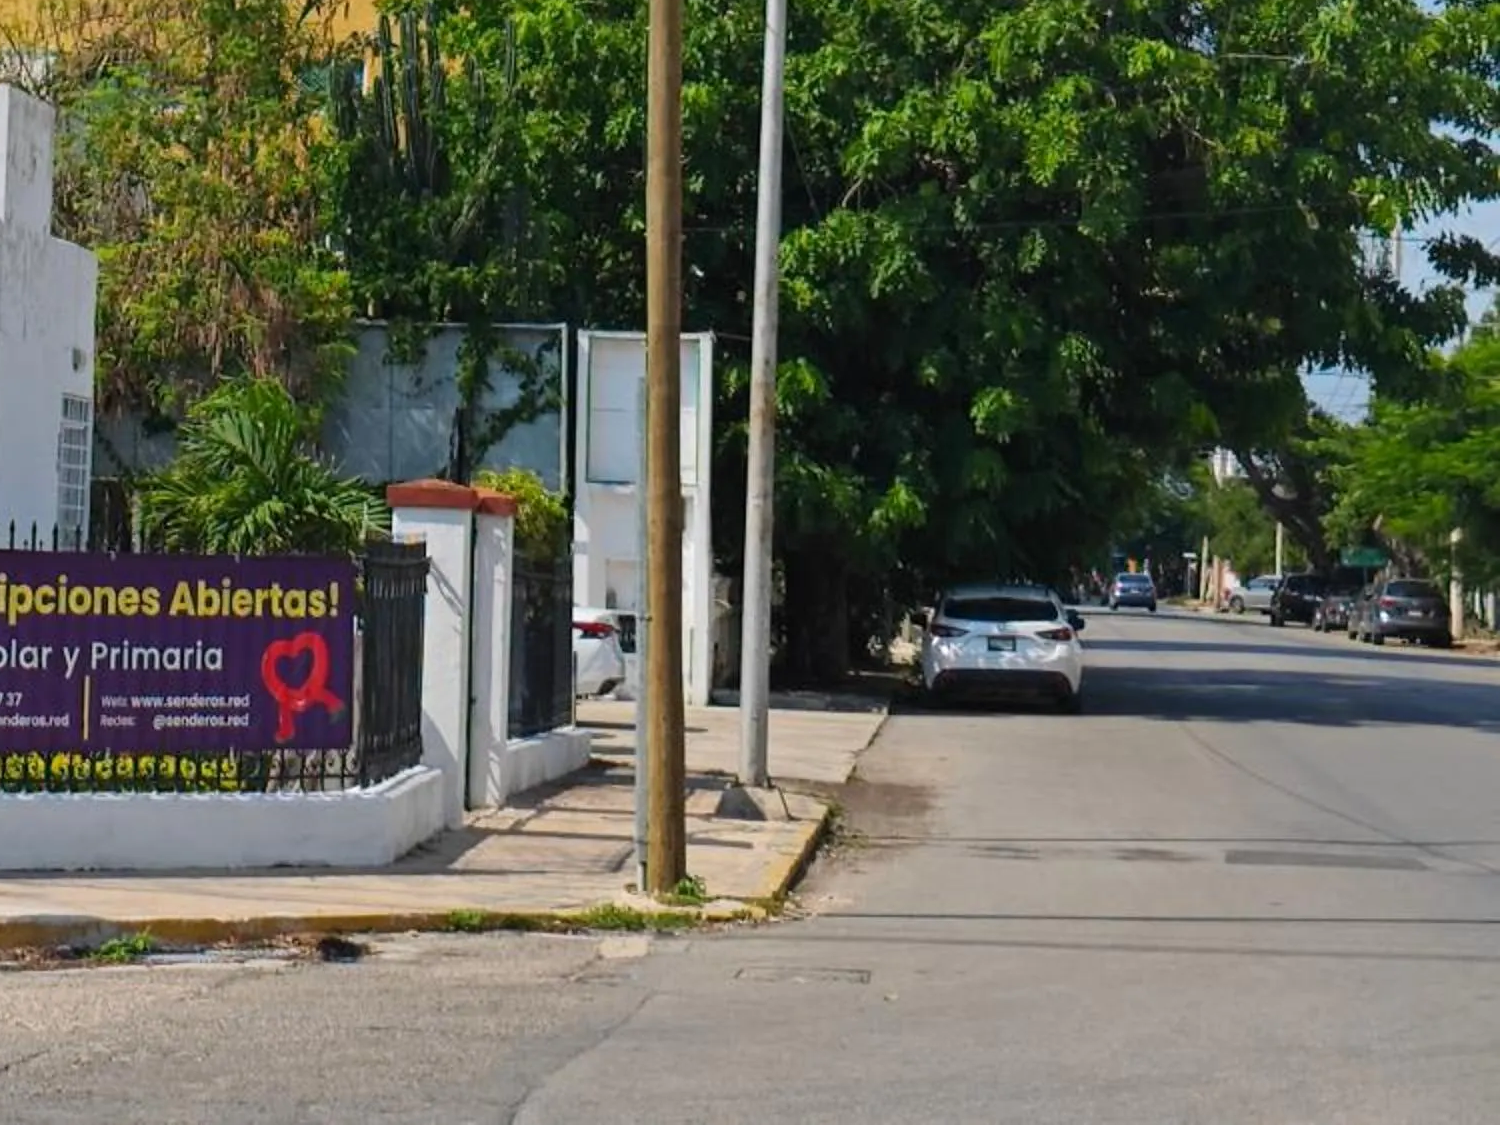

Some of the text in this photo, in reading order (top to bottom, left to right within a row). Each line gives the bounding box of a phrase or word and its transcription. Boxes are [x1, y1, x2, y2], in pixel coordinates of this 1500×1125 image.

[169, 576, 339, 618] Abiertas!
[63, 646, 80, 679] y
[91, 639, 224, 671] Primaria
[131, 692, 250, 708] www.senderos.red
[153, 712, 249, 730] @senderos.red
